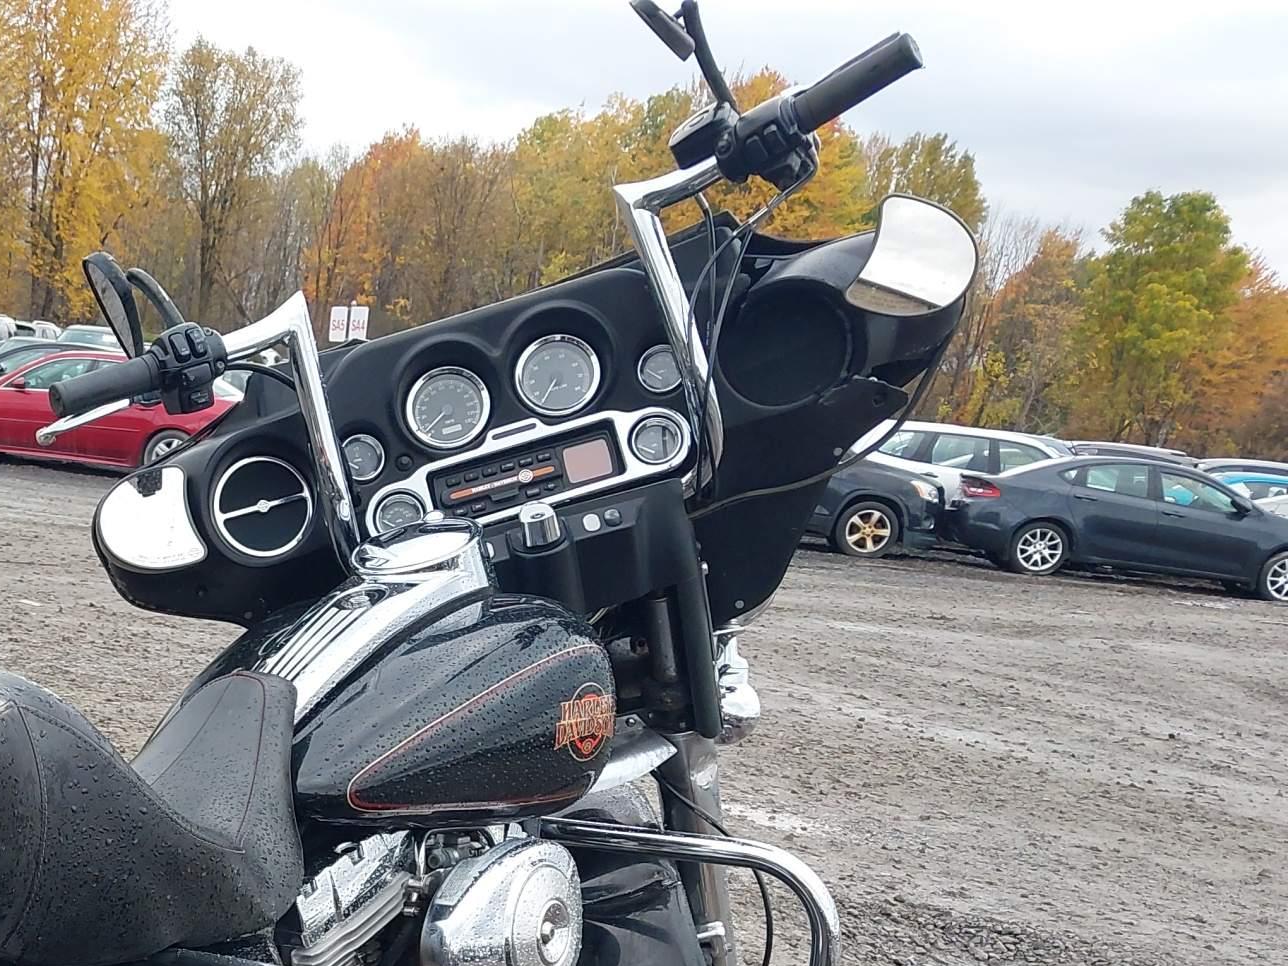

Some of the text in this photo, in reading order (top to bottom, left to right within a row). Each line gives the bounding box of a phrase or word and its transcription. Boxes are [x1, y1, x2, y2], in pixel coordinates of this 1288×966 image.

[351, 319, 366, 331] SA4
[560, 694, 617, 722] HARLEY
[554, 714, 615, 749] DAVIDSON
